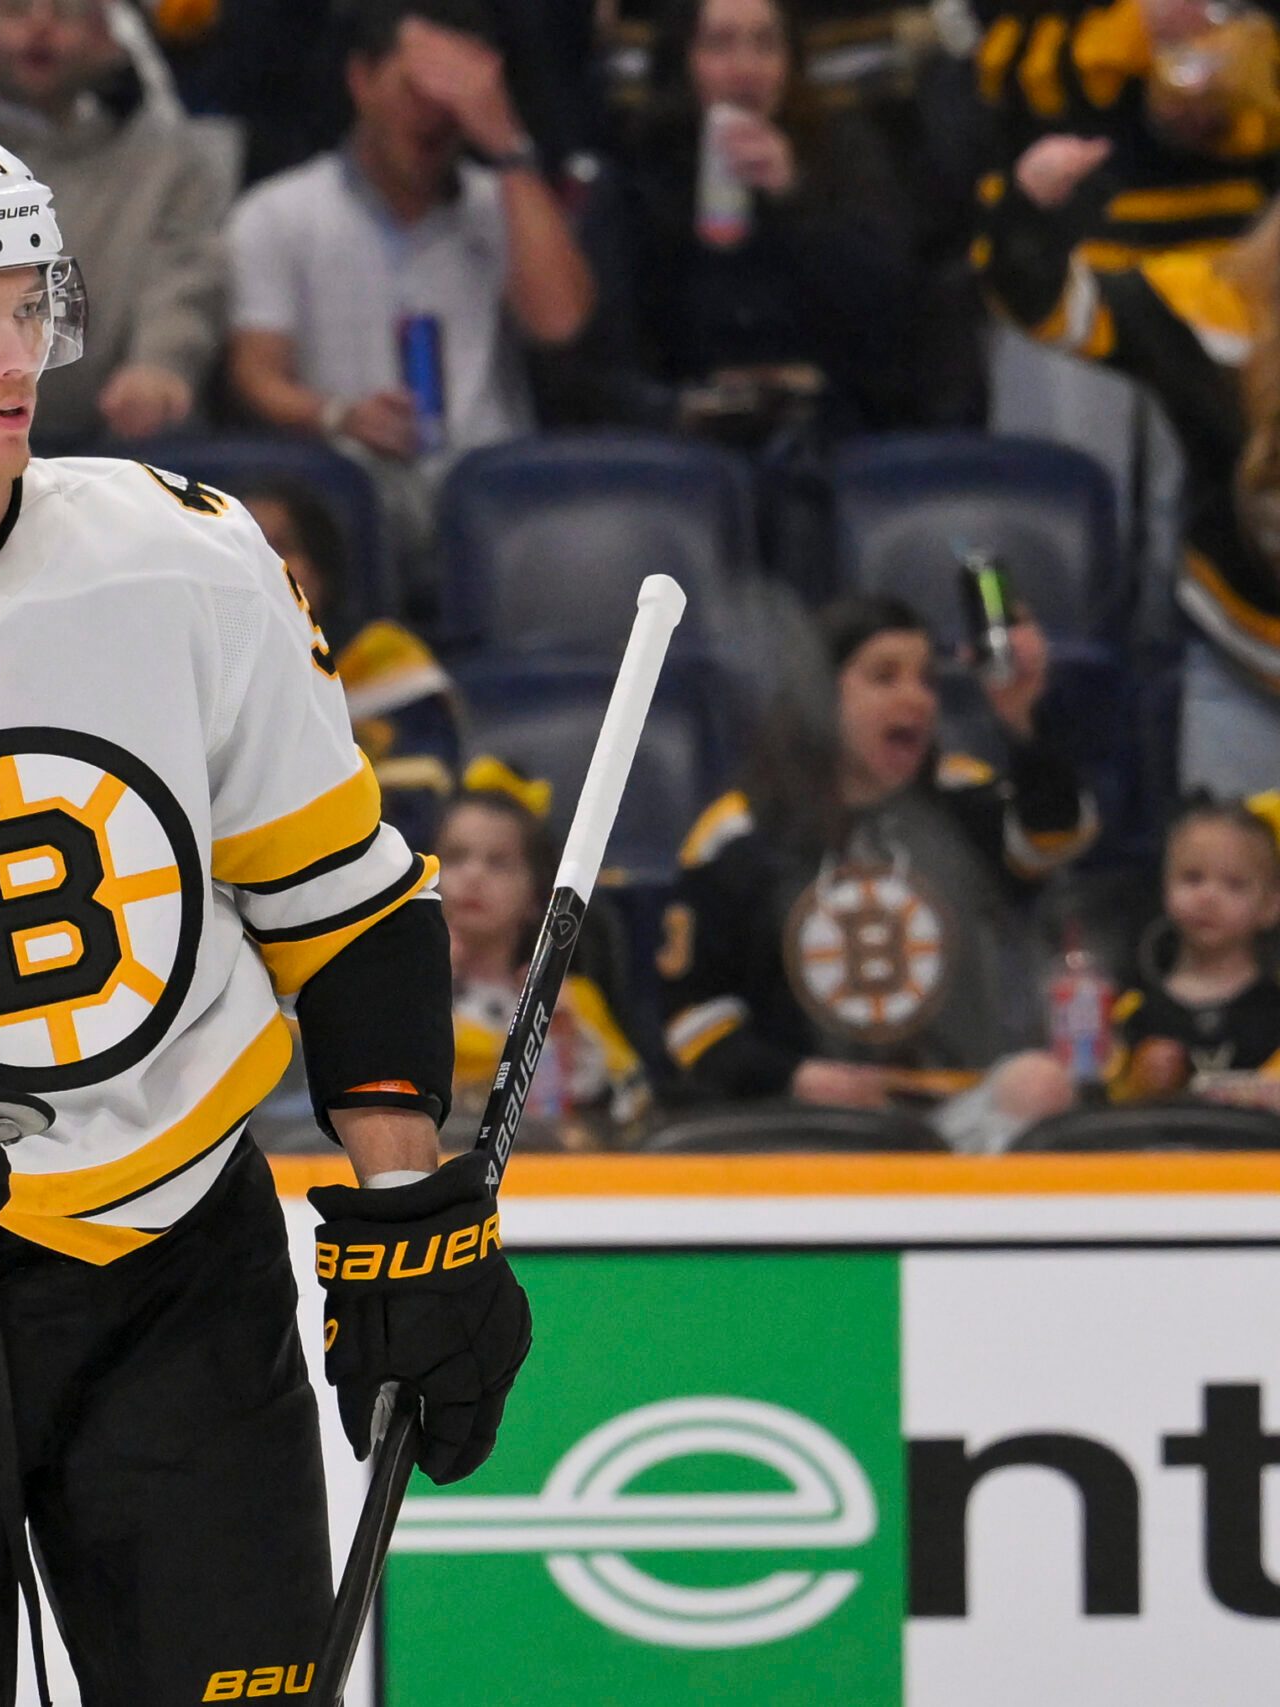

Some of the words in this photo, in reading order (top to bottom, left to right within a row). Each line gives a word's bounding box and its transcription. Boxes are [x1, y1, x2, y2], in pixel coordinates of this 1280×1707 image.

[493, 1061, 511, 1091] GEEKIE
[495, 1001, 549, 1168] BAUER
[315, 1212, 503, 1281] BAUER
